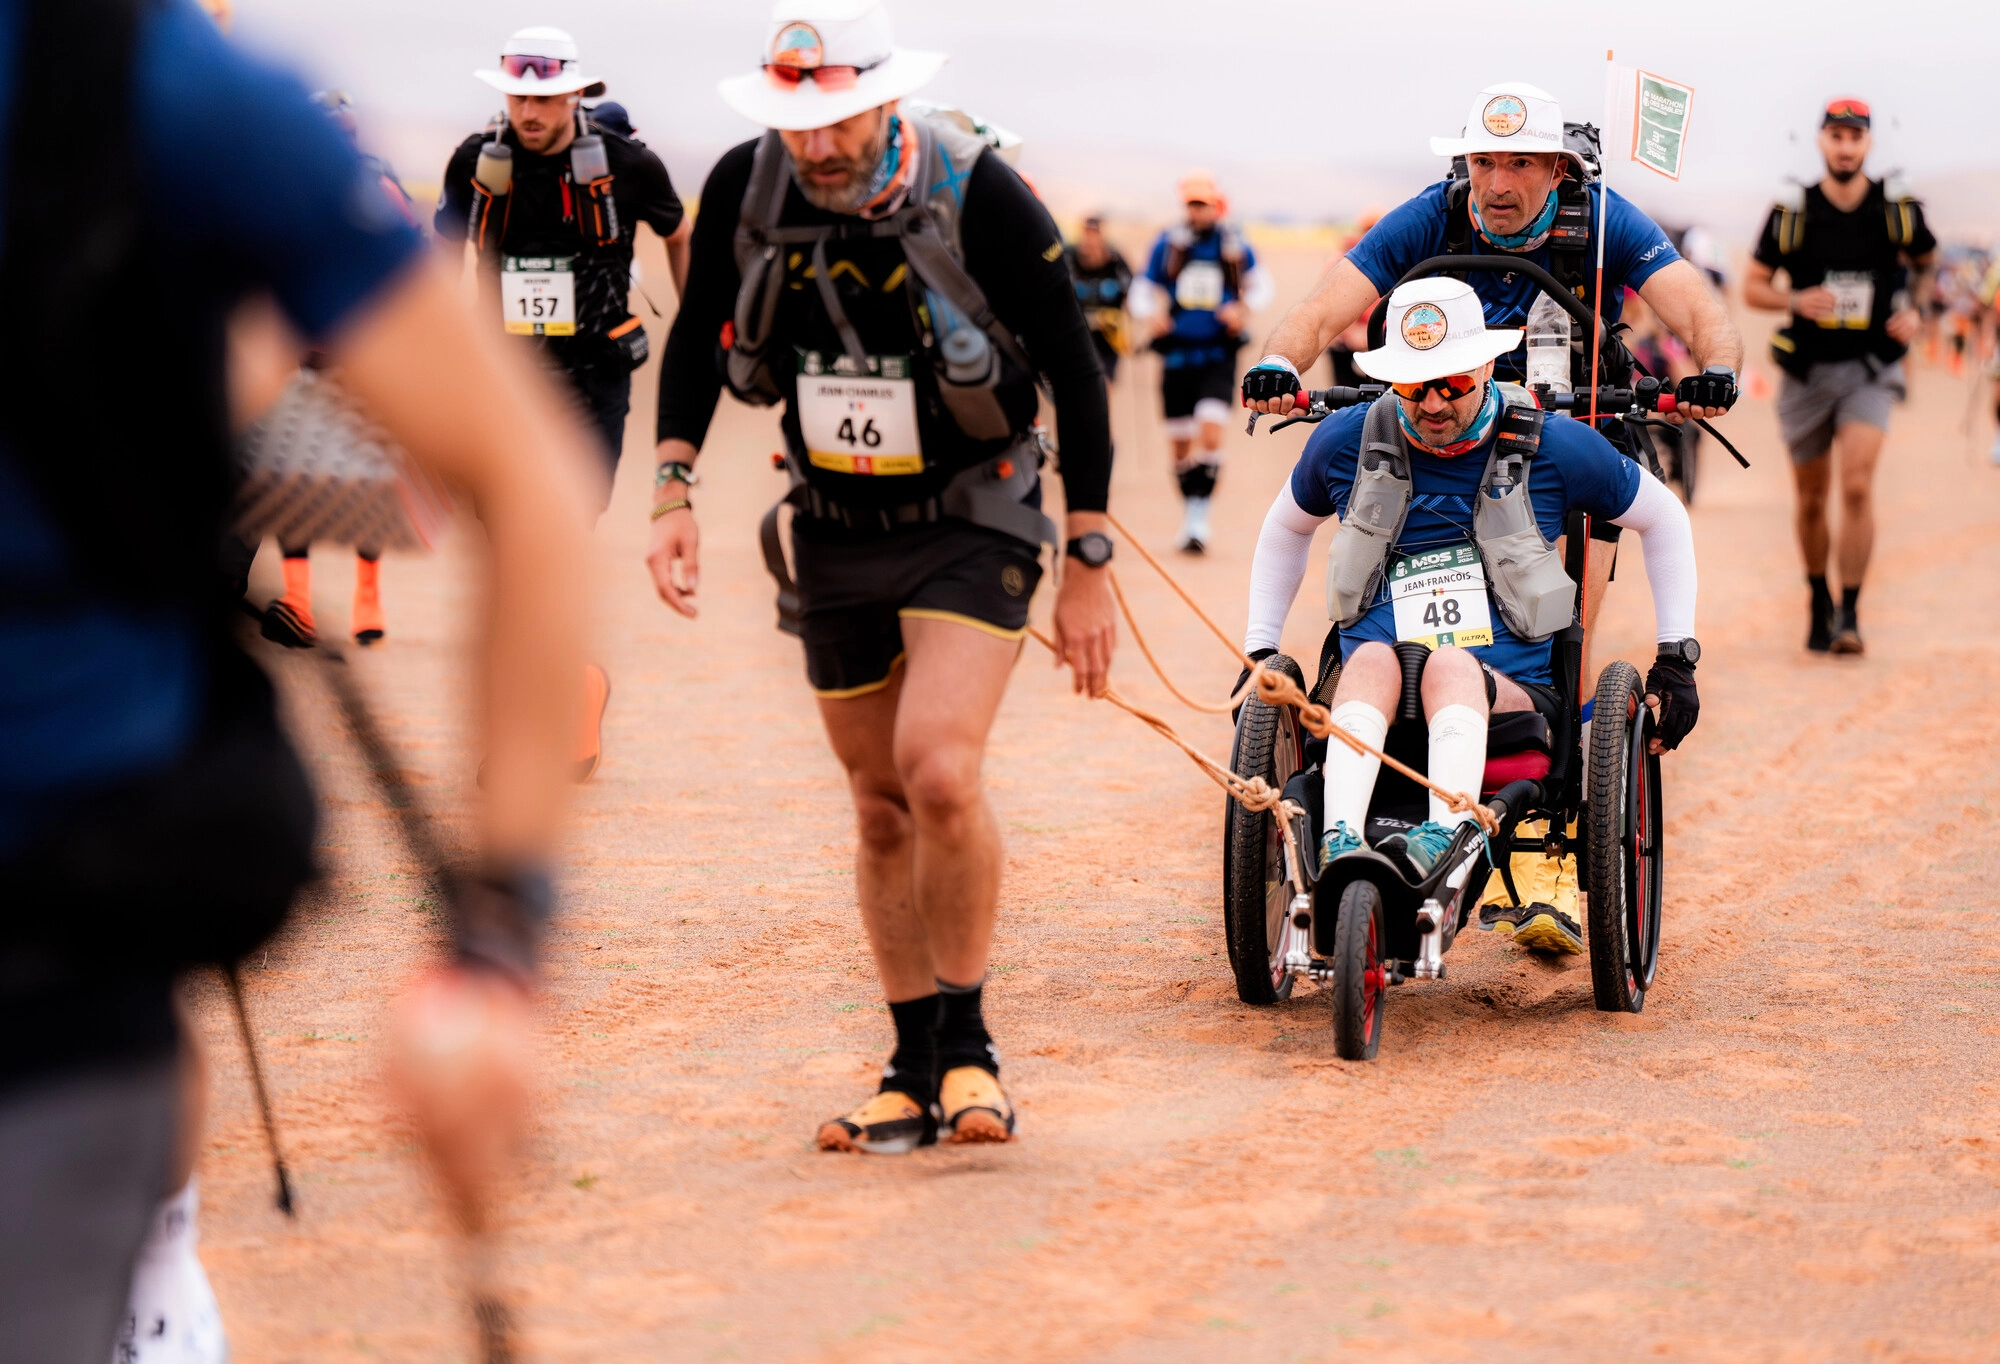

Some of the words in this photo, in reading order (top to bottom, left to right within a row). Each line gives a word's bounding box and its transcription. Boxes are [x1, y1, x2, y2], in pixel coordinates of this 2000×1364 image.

[1650, 93, 1685, 109] MARATHON
[1519, 128, 1559, 142] SALOMON
[517, 297, 559, 317] 157
[836, 418, 882, 448] 46
[1411, 551, 1452, 568] MDS
[1423, 598, 1461, 628] 48
